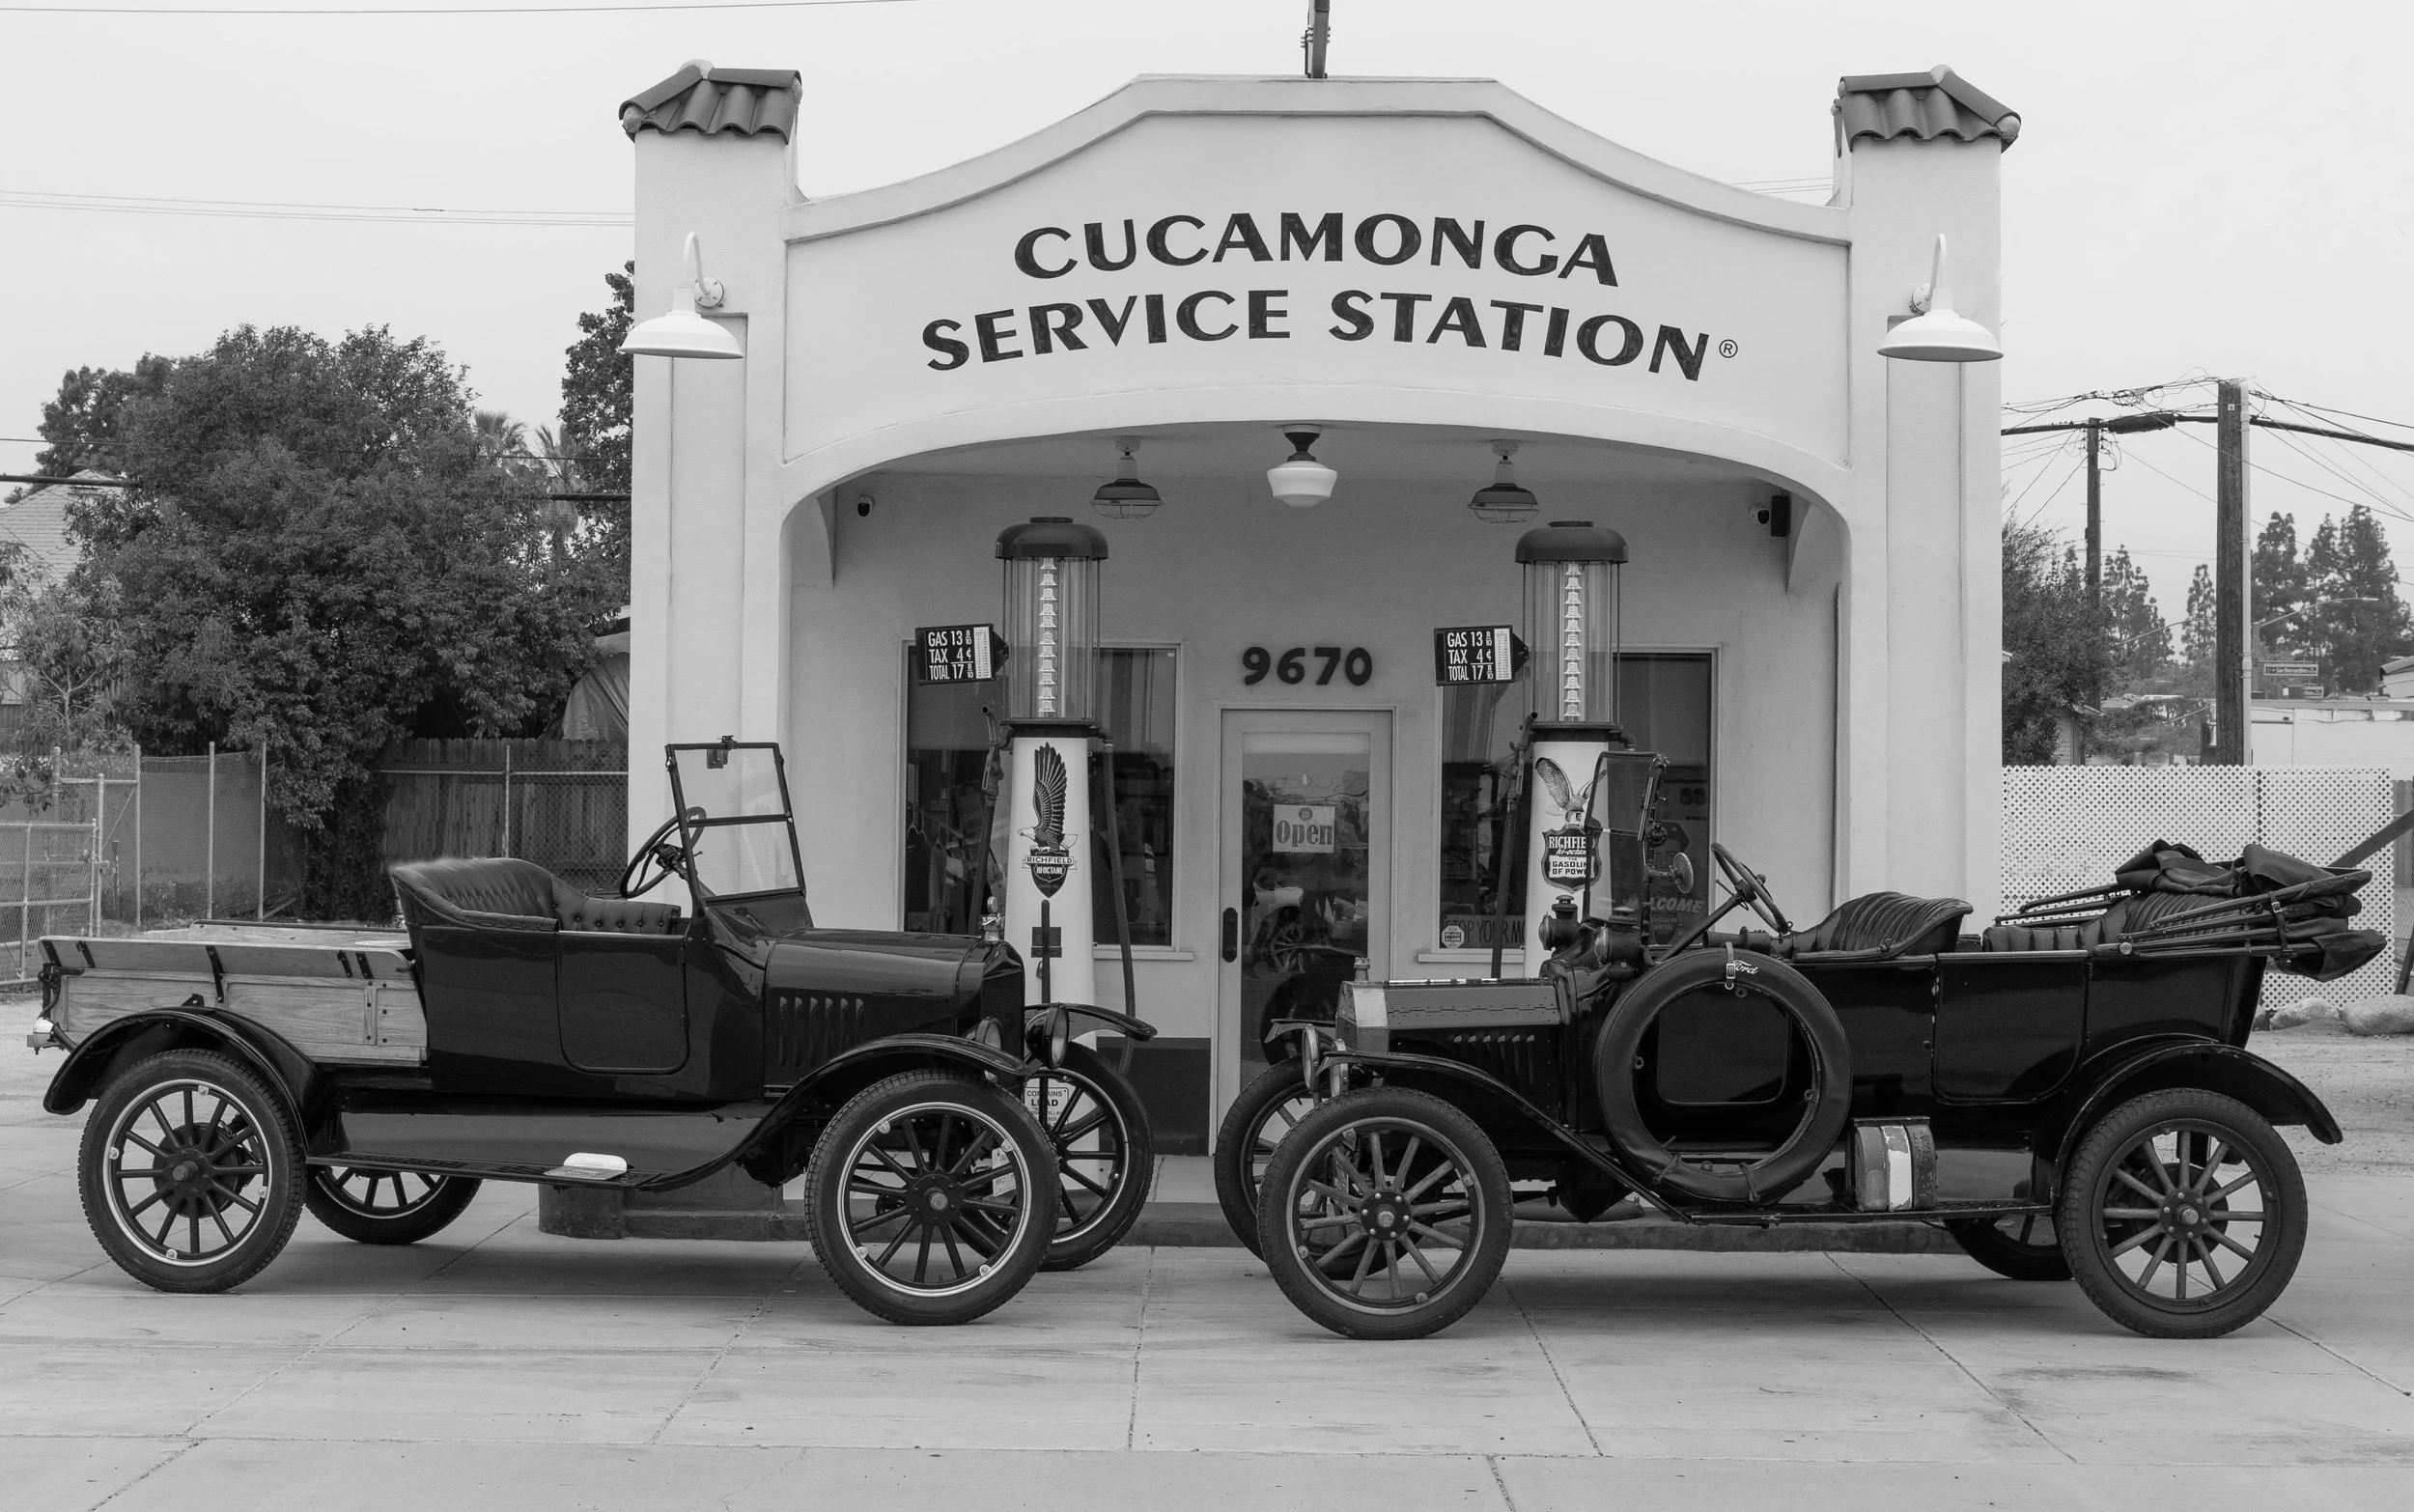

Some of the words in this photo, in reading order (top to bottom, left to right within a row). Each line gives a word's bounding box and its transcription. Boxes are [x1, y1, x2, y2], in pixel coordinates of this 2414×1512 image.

[1014, 212, 1618, 288] CUCAMONGA
[922, 290, 1291, 371] SERVICE
[928, 630, 947, 647] GAS
[951, 630, 963, 645] 13
[1447, 631, 1468, 647] GAS
[1471, 631, 1483, 647] 13
[929, 648, 948, 663] TAX
[1448, 649, 1468, 664] TAX
[929, 664, 950, 680] TOTAL
[952, 664, 964, 679] 17
[1242, 646, 1372, 686] 9670
[1448, 665, 1469, 681] TOTAL
[1472, 665, 1483, 680] 17
[1276, 820, 1333, 847] Open
[1549, 836, 1595, 849] RICHFIE
[1477, 919, 1509, 943] YOR
[1733, 959, 1758, 974] Ford
